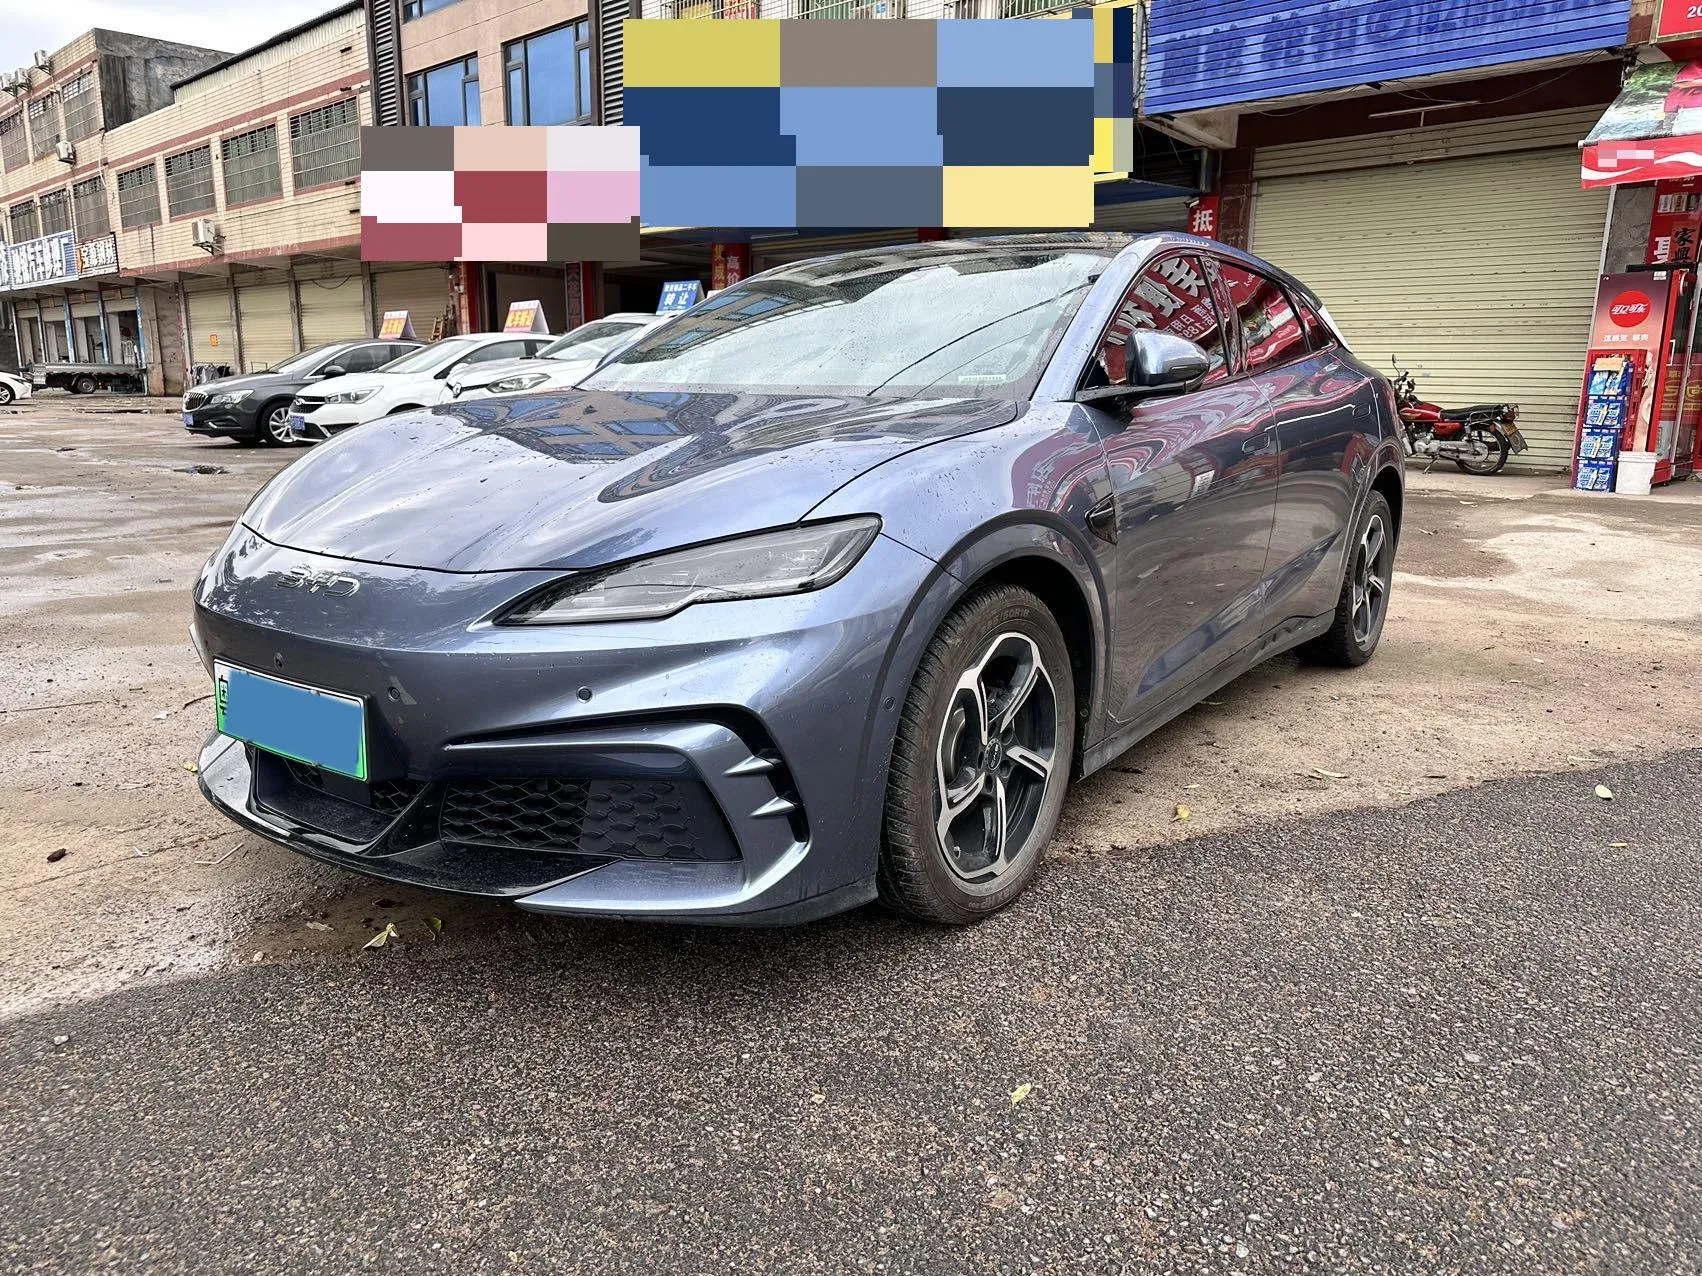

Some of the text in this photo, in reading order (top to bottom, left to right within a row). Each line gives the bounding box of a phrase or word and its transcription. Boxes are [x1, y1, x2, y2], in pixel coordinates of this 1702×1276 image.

[1192, 209, 1213, 239] 抵
[663, 291, 690, 306] 转让
[1611, 303, 1648, 315] 可口可乐
